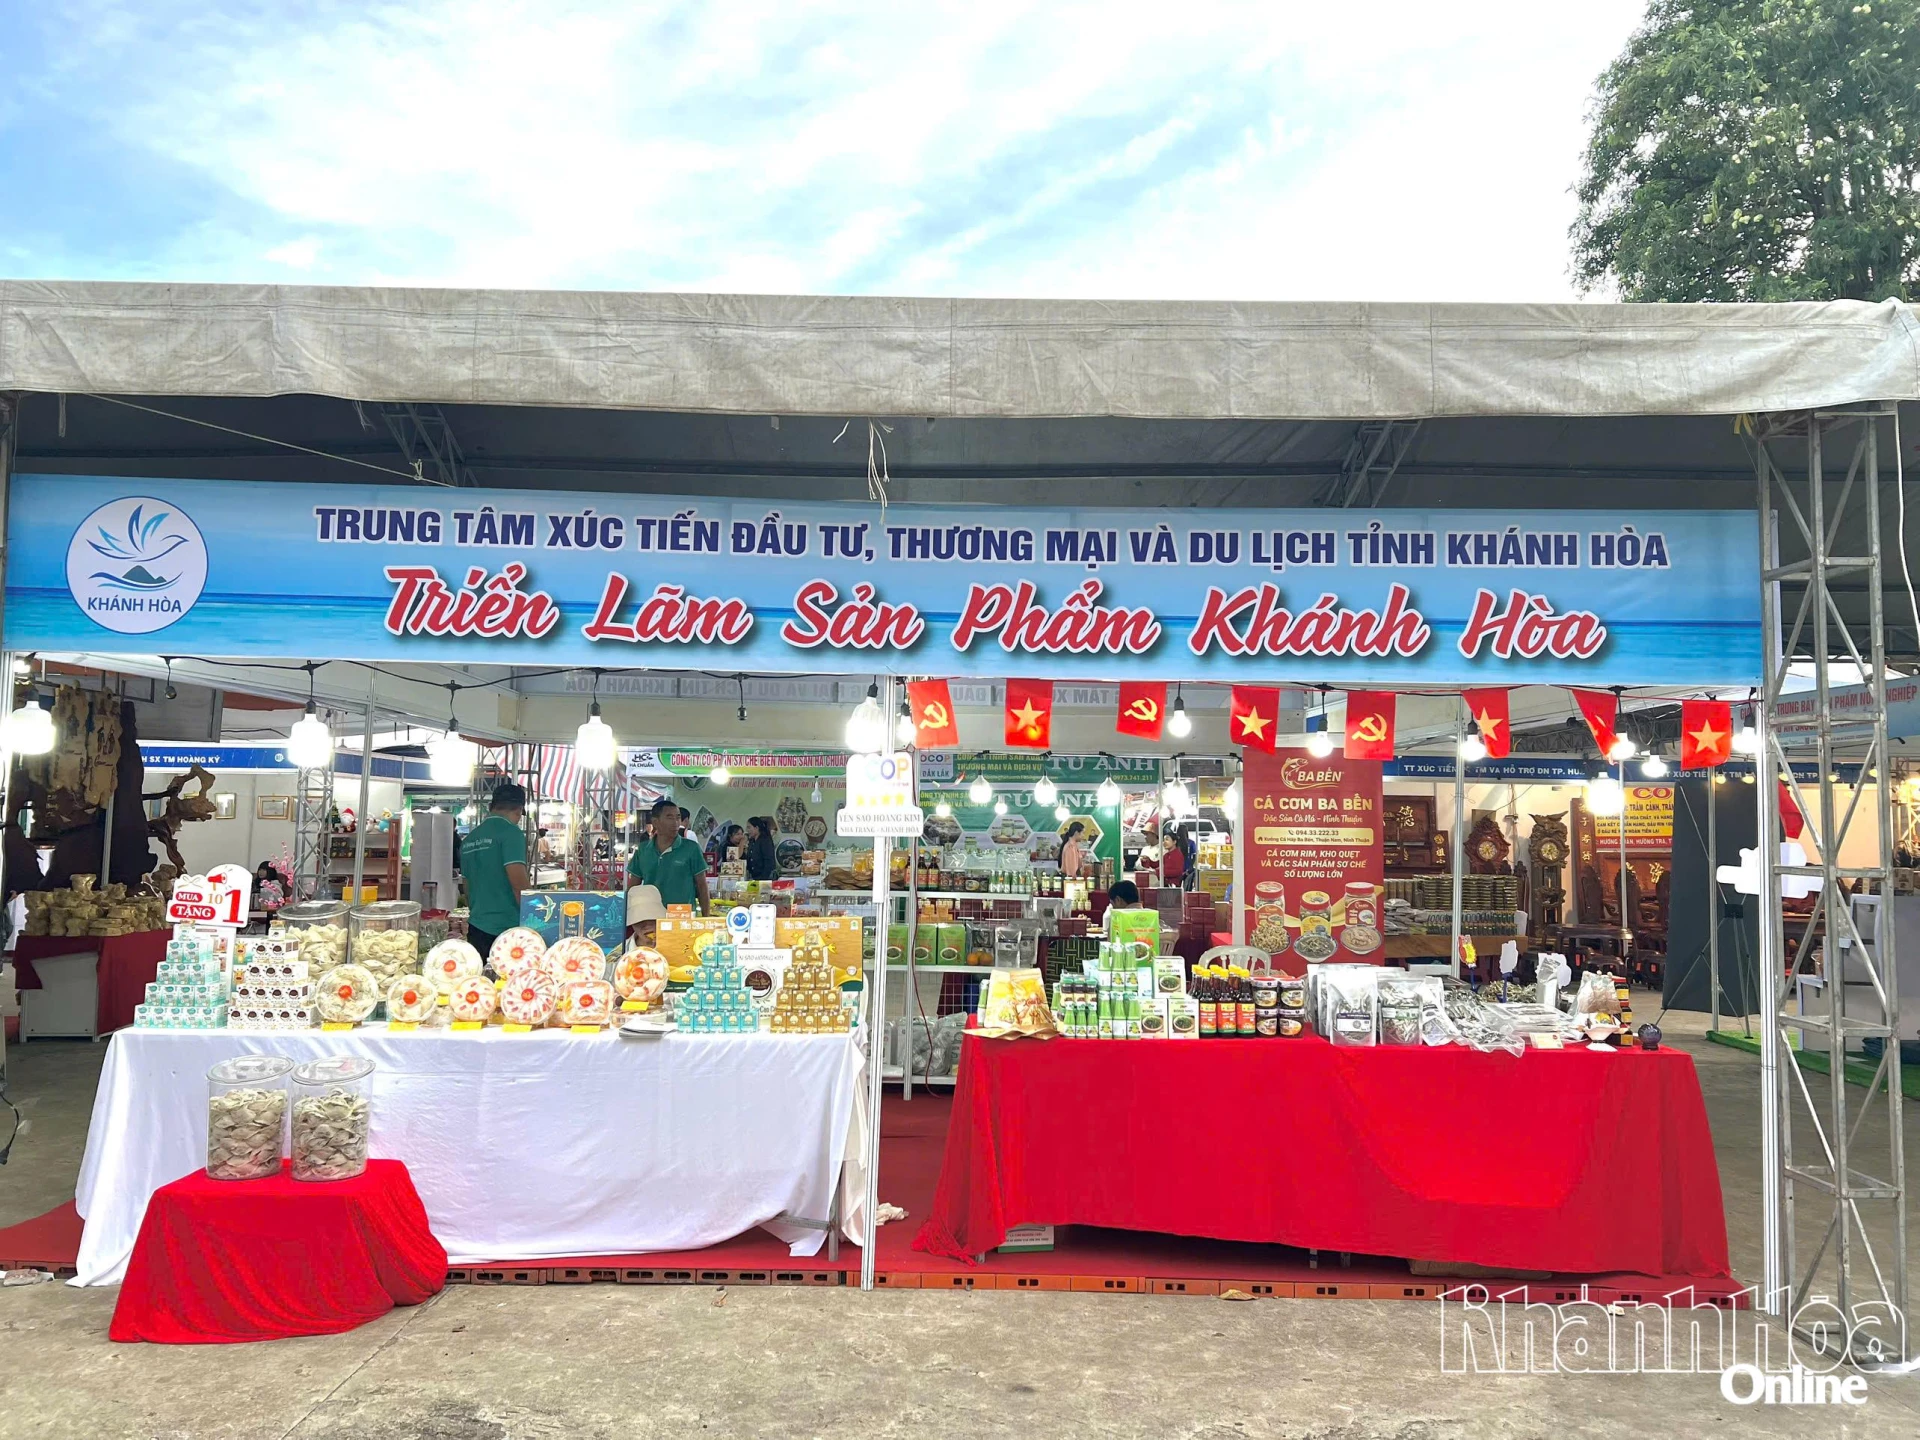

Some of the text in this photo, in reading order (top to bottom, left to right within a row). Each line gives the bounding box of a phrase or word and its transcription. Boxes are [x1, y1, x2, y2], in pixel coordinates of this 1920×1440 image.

[316, 506, 1669, 573] TRUNG TÂM XÚC TIẾN ĐẦU TƯ, THƯƠNG MẠI VÀ DU LỊCH TỈNH KHÁNH HÒA
[87, 594, 182, 613] KHÁNH HÒA
[385, 562, 1606, 661] Triển Lãm Sản Phẩm Khánh Hòa
[149, 756, 161, 764] SX
[163, 756, 176, 764] TM
[177, 754, 207, 764] HOÀNG
[692, 753, 700, 766] TY
[734, 755, 743, 767] SX
[1093, 757, 1155, 771] ANH
[1297, 767, 1342, 782] BA BẾN
[1404, 764, 1415, 772] TT
[1254, 793, 1373, 811] CÁ CƠM BA BẾN
[1266, 848, 1278, 857] CÁ
[1279, 849, 1299, 858] CƠM
[1300, 849, 1318, 859] RIM,
[1319, 850, 1336, 858] KHO
[1260, 858, 1272, 867] VÀ
[1273, 859, 1290, 867] CÁC
[1291, 859, 1308, 868] SẢN
[1310, 858, 1335, 868] PHẨM
[1337, 860, 1348, 868] SƠ
[1284, 868, 1343, 880] SỐ LƯỢNG LỚN
[176, 904, 212, 919] TẶNG
[178, 888, 244, 924] MUA 10 1
